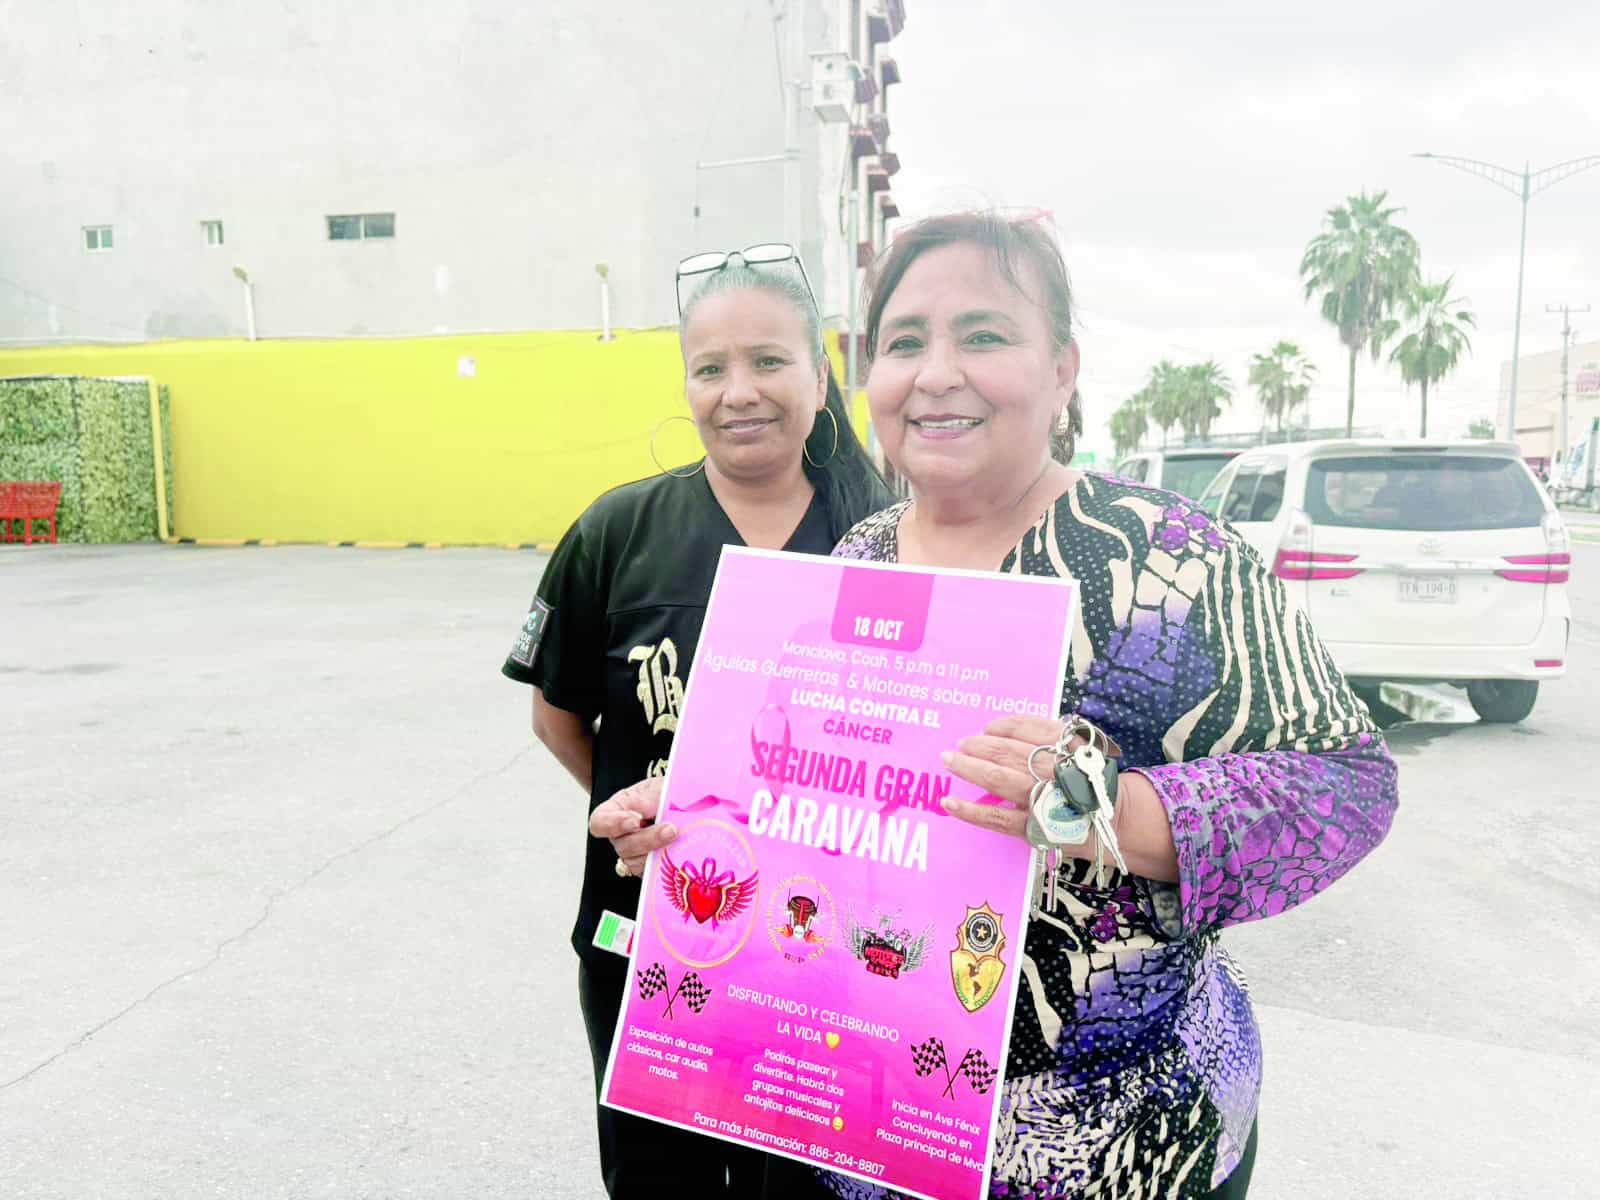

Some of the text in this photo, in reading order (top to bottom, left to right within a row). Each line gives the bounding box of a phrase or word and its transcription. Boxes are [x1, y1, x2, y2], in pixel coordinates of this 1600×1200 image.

[854, 616, 904, 640] 18 OCT
[895, 656, 903, 670] 5
[906, 660, 932, 676] p.m
[936, 665, 946, 676] a
[950, 663, 959, 677] 11
[960, 667, 989, 682] p.m
[761, 659, 840, 686] Guerreras
[846, 672, 857, 689] &
[863, 676, 928, 699] Motores
[932, 687, 982, 707] sobre
[985, 695, 1049, 716] ruedas
[790, 688, 942, 728] LUCHA CONTRA EL
[823, 716, 893, 744] CÁNCER
[751, 740, 952, 812] SEGUNDA GRAN
[748, 789, 928, 873] CARAVANA
[727, 984, 900, 1042] DISFRUTANDO Y CELEBRANDO
[629, 1024, 714, 1056] Exposición de autos
[777, 1020, 822, 1044] LA VIDA
[664, 1051, 680, 1063] car
[764, 1048, 838, 1080] Podrás pasear y
[752, 1079, 840, 1113] grupos musicales y
[796, 1075, 825, 1092] Habrá
[827, 1082, 844, 1096] dos
[744, 1092, 831, 1127] antojitos deliciosos
[892, 1099, 981, 1135] Inicia en Ave Fénix
[694, 1112, 885, 1176] Para más información: 866-204-8807
[876, 1128, 902, 1145] Plaza
[904, 1136, 946, 1161] principal
[948, 1150, 962, 1163] de
[892, 1116, 972, 1150] Concluyendo en
